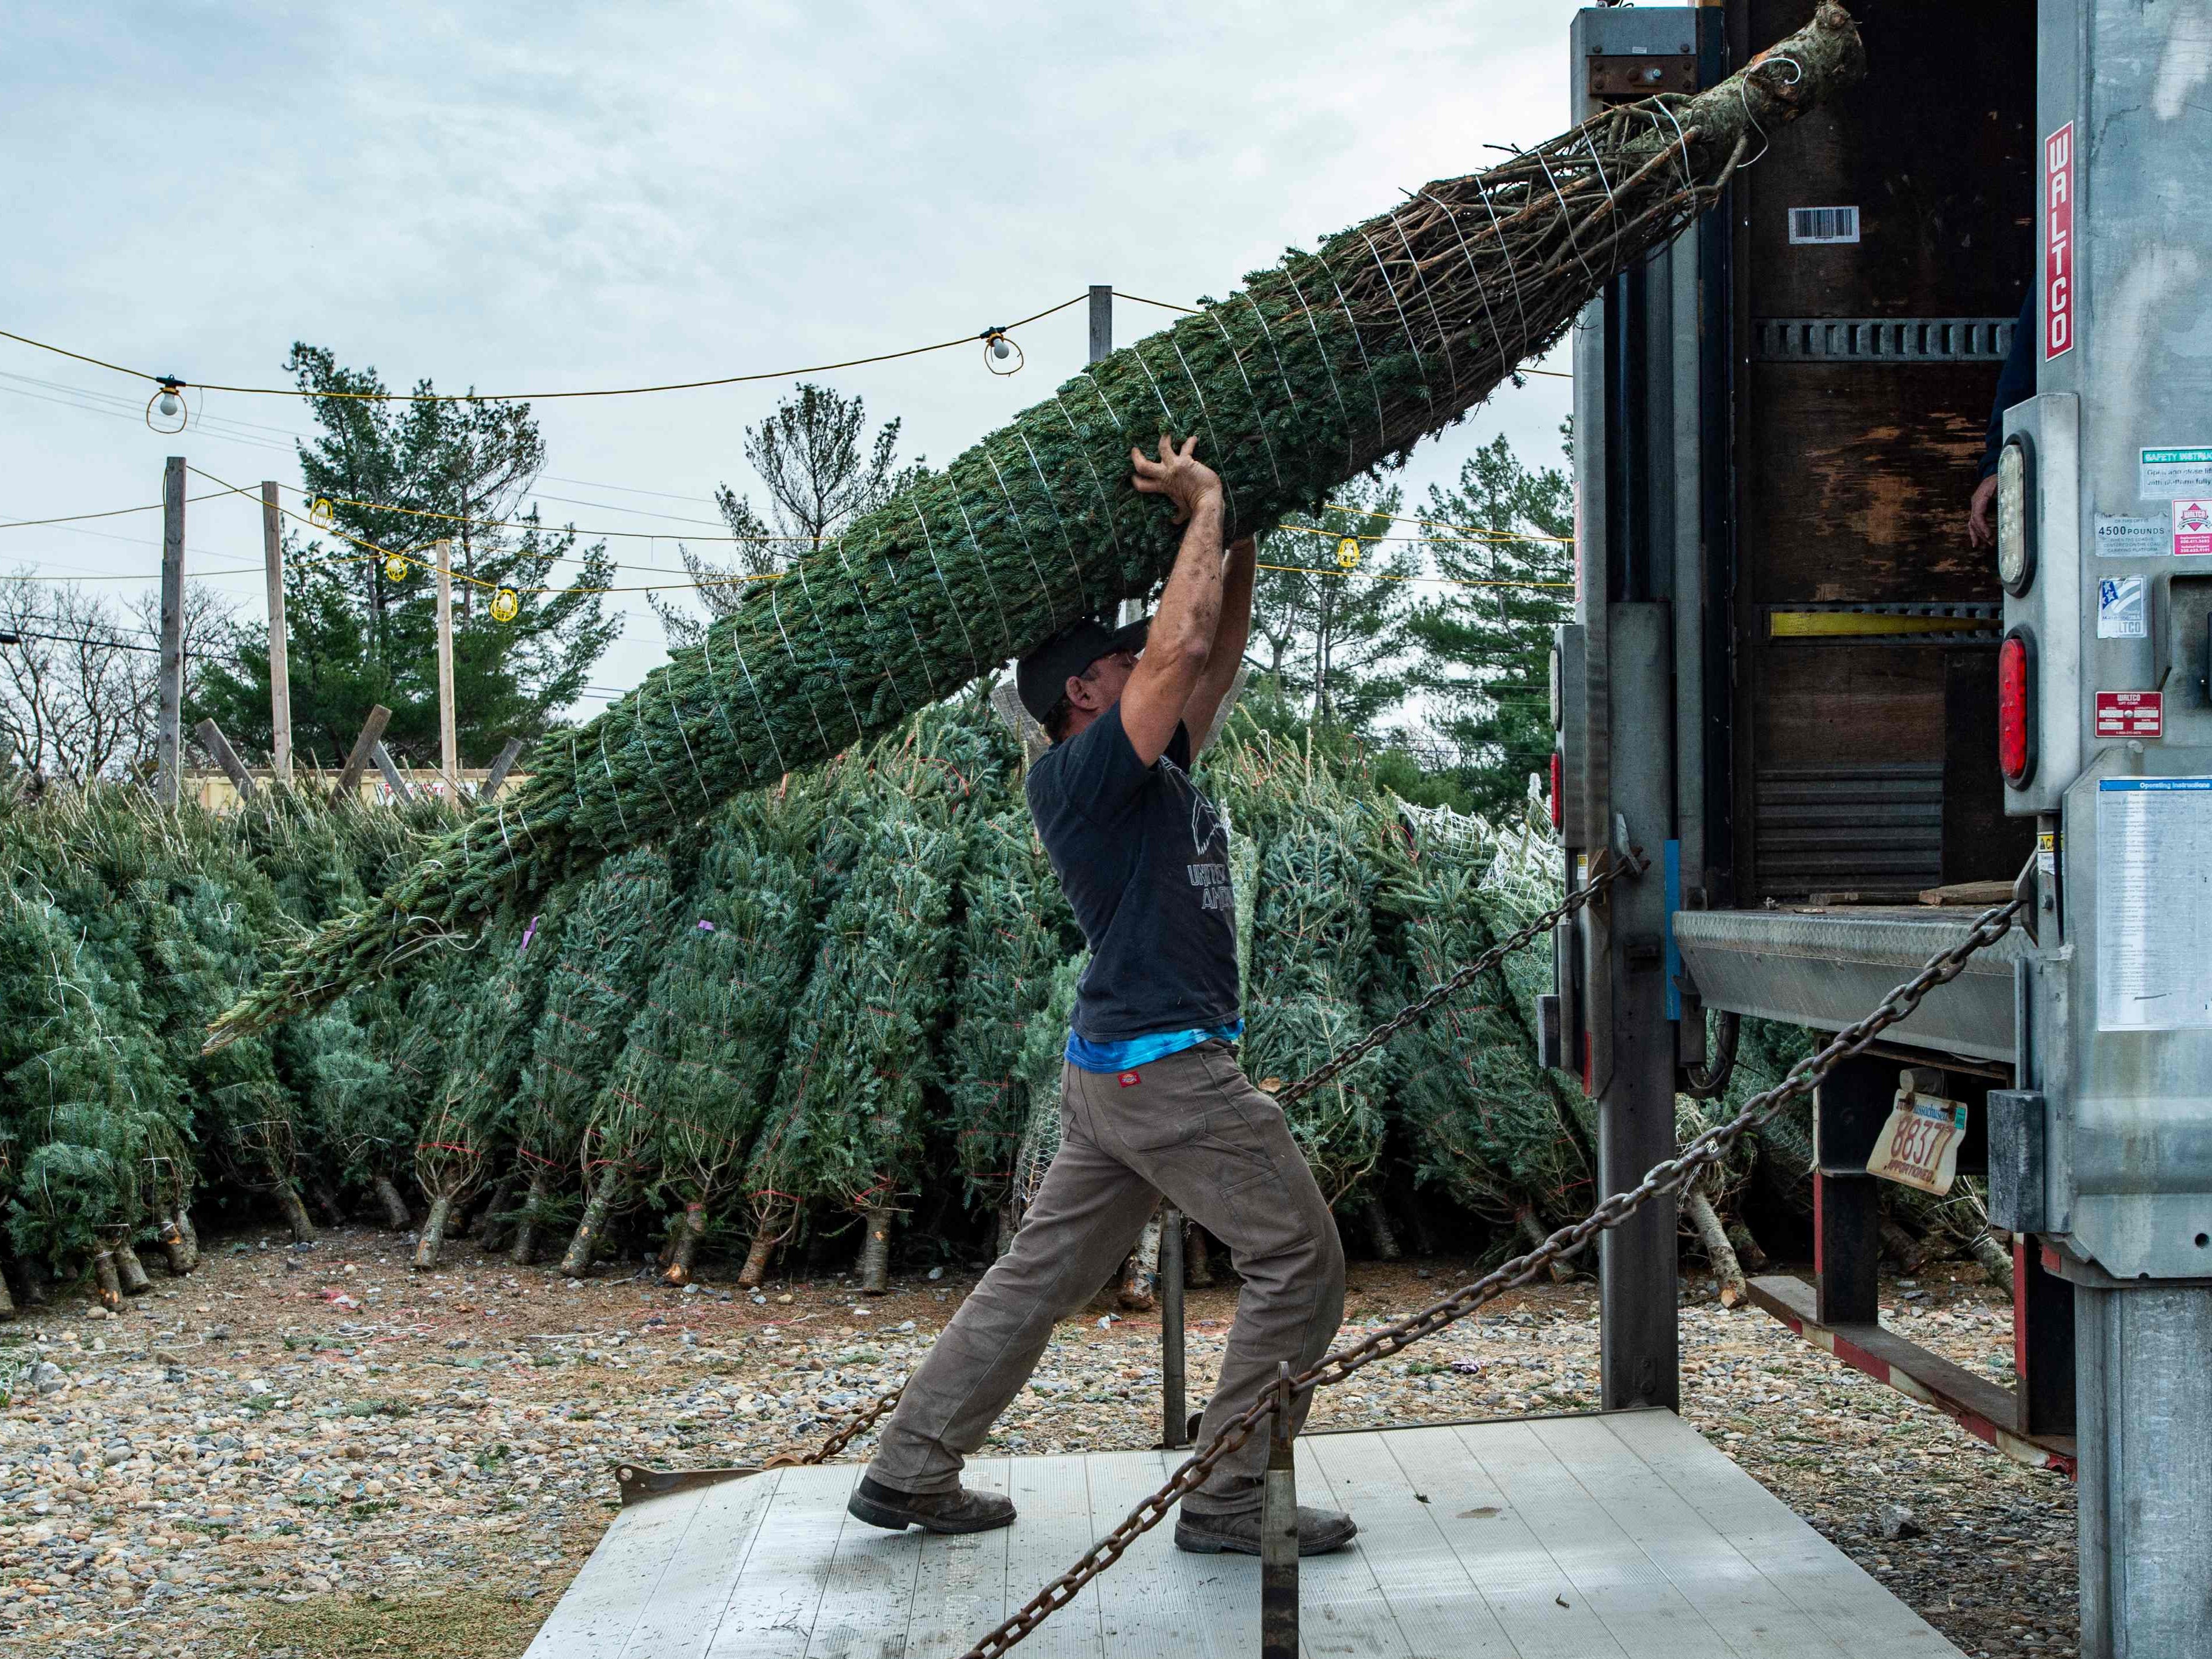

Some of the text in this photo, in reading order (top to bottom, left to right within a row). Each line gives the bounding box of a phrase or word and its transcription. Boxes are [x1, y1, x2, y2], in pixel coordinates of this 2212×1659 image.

[2050, 133, 2068, 348] WALTCO
[2145, 453, 2177, 461] SAFETY
[2099, 526, 2126, 535] 4500
[1891, 1116, 1956, 1169] 88377
